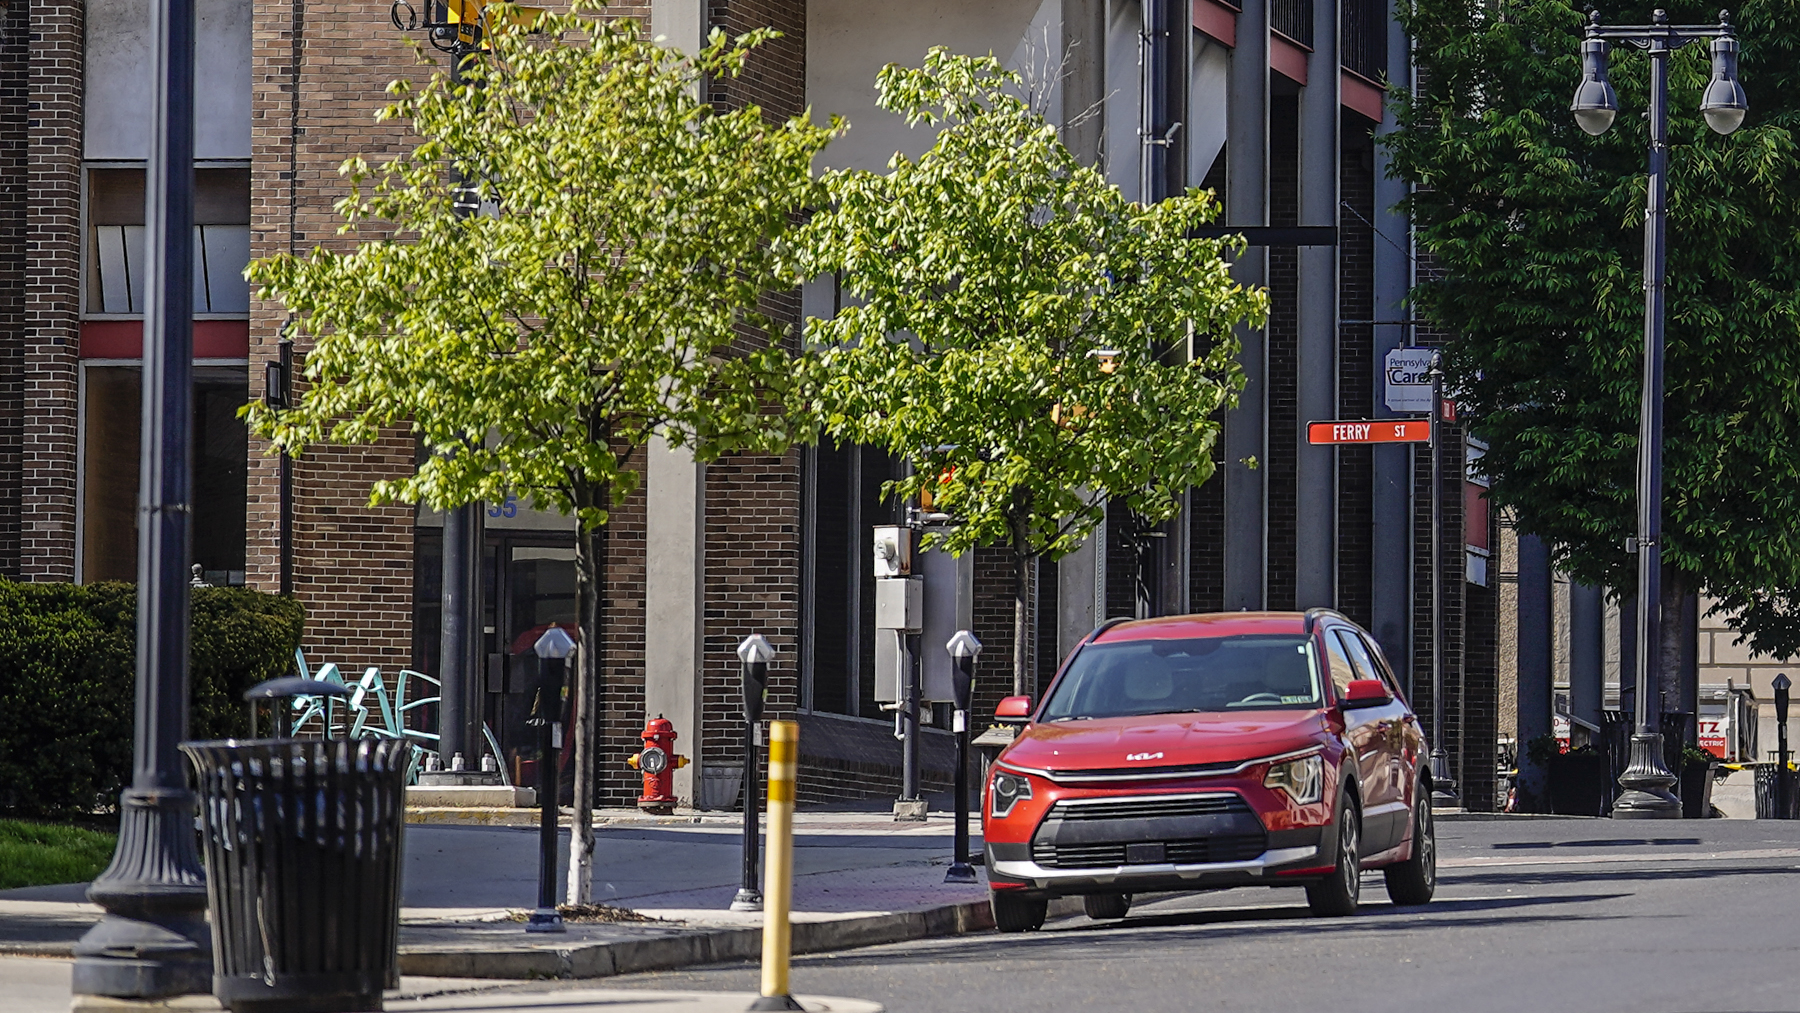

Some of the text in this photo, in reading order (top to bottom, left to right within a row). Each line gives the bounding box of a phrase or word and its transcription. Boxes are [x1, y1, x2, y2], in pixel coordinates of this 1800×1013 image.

[1390, 358, 1431, 369] Pennsylva
[1333, 424, 1406, 441] FERRY ST
